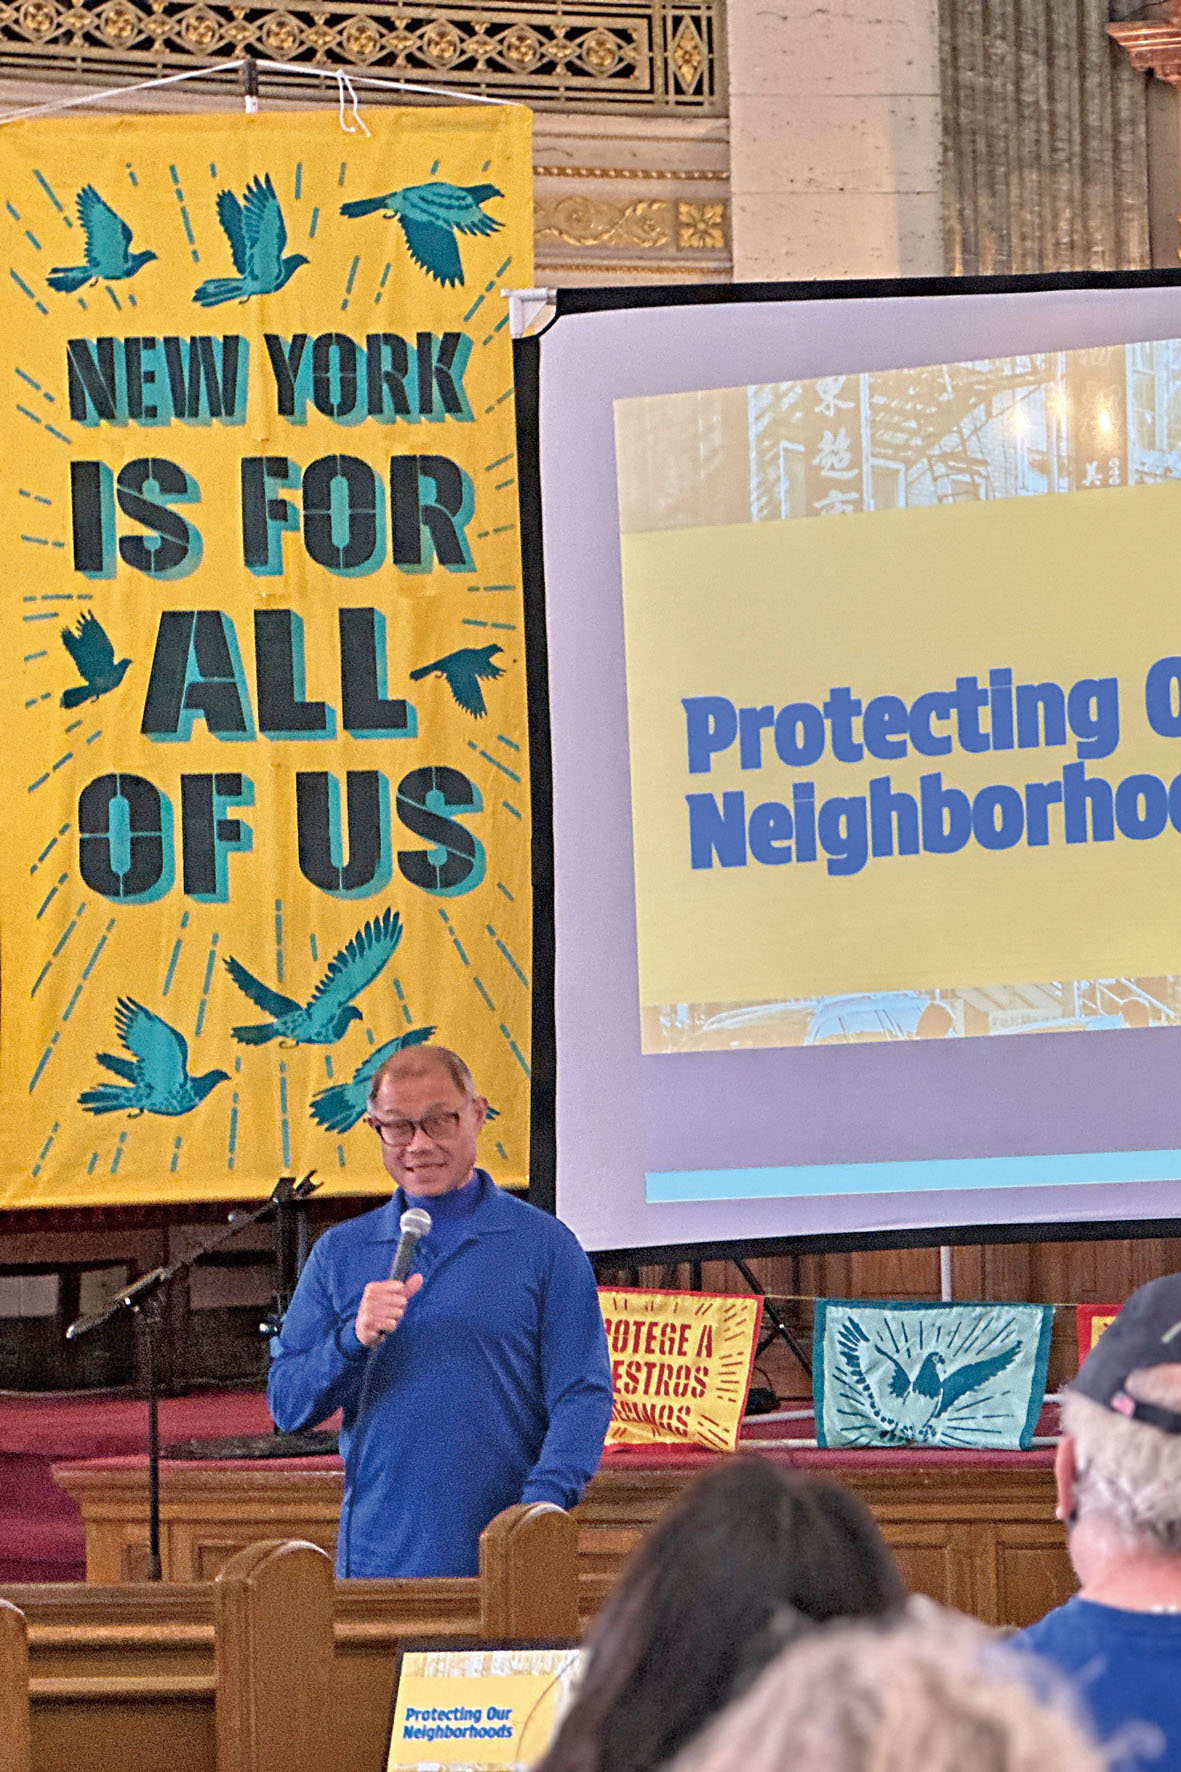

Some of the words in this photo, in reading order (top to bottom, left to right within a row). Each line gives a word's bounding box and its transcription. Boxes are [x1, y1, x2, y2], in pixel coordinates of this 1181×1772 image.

[66, 334, 250, 427] NEW
[262, 332, 476, 425] YORK
[69, 456, 203, 581] IS
[240, 454, 478, 580] FOR
[140, 606, 419, 743] ALL
[680, 666, 1121, 775] Protecting
[77, 771, 256, 905] OF
[295, 765, 487, 904] US
[696, 1324, 713, 1359] A
[403, 1725, 512, 1741] Neighborhoods
[406, 1707, 482, 1722] Protecting
[487, 1707, 512, 1720] Our
